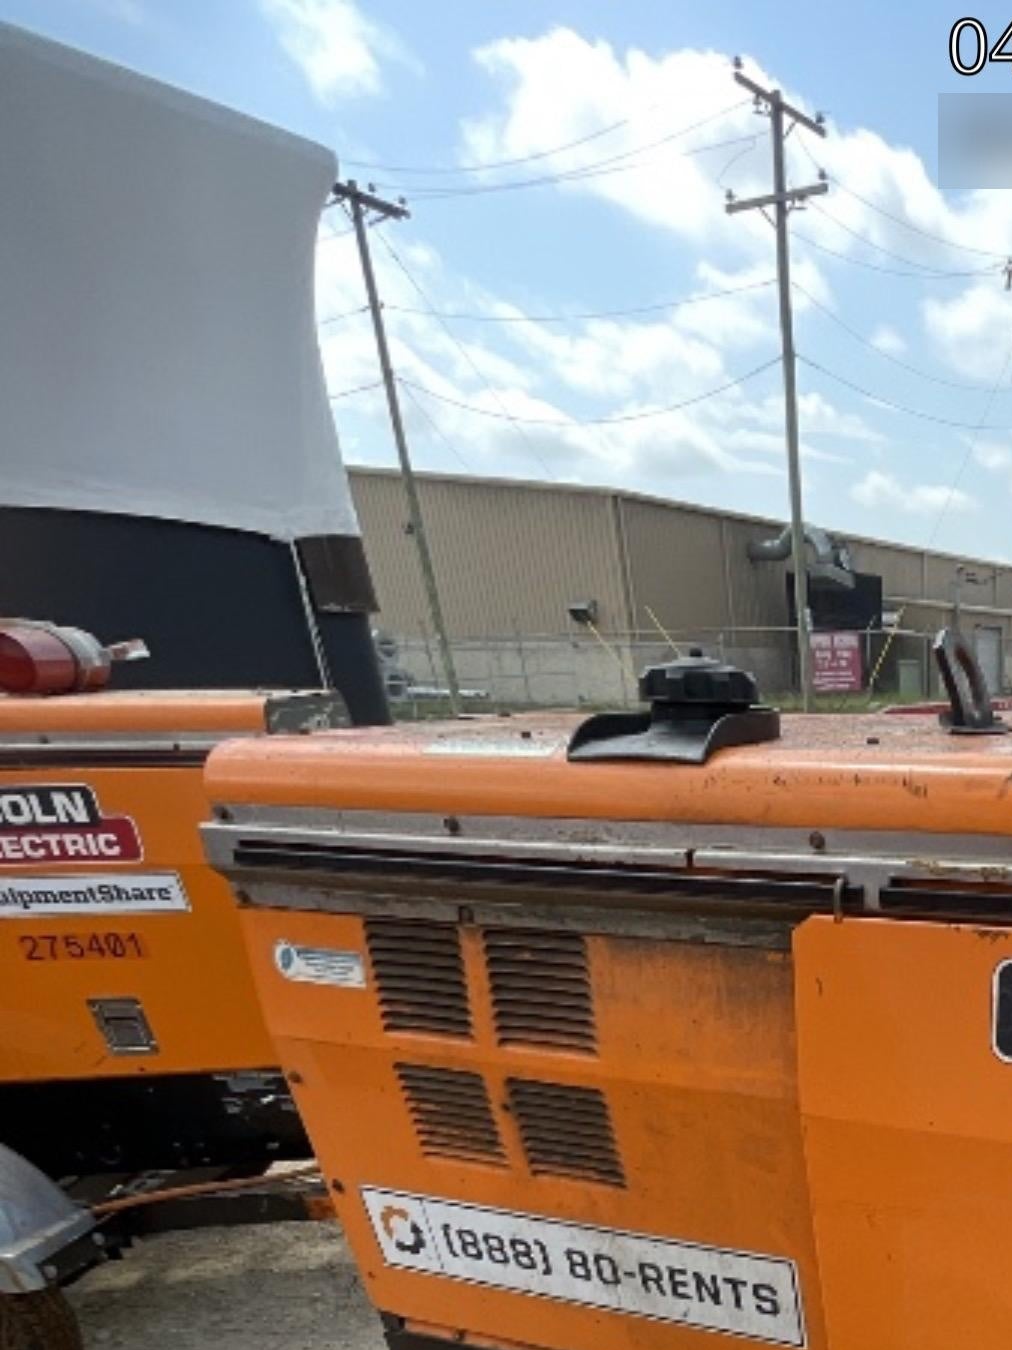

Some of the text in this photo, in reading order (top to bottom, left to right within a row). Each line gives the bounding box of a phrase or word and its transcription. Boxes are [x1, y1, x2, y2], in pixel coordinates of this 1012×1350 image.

[0, 791, 91, 826] OLN
[19, 931, 144, 961] 275401
[441, 1223, 782, 1316] (888) 80-RENTS
